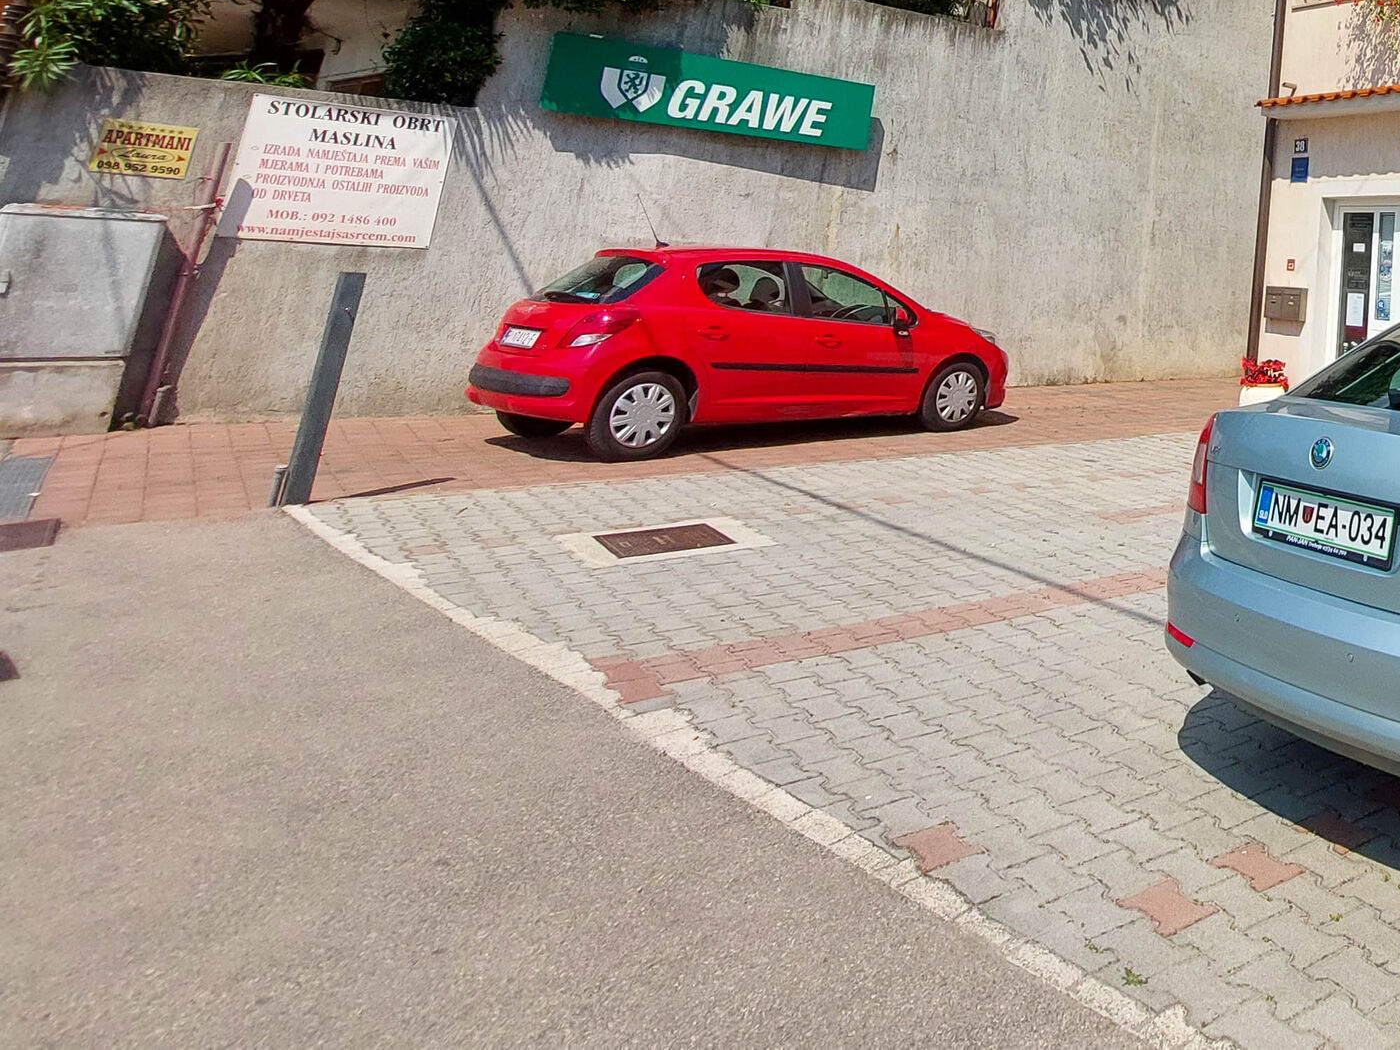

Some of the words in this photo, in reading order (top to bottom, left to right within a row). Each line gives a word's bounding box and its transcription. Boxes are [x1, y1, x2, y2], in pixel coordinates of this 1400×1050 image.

[268, 101, 382, 126] STOLARSKI
[393, 115, 445, 133] OBRT
[667, 79, 833, 138] GRAWE
[102, 129, 193, 151] APARTMANI
[308, 128, 396, 150] MASLINA
[1295, 140, 1305, 152] 38
[118, 149, 168, 161] Laura
[263, 144, 300, 157] IZRADA
[306, 148, 369, 164] NAMJEŠTAJA
[374, 154, 406, 168] PREMA
[413, 156, 440, 170] VAŠIM
[96, 160, 120, 170] 098
[124, 163, 148, 173] 952
[150, 165, 181, 175] 9590
[259, 158, 309, 173] MJERAMA
[314, 164, 320, 174] I
[324, 165, 384, 179] POTREBAMA
[251, 187, 267, 199] OD
[272, 189, 312, 203] DRVETA
[255, 173, 326, 189] PROIZVODNJA
[331, 180, 372, 193] OSTALIH
[376, 183, 429, 198] PROIZVODA
[266, 209, 308, 222] MOB.:
[311, 212, 335, 223] 092
[339, 213, 371, 225] 1486
[373, 216, 397, 227] 400
[237, 224, 416, 243] www.namjestajsasrcem.com
[1270, 492, 1302, 527] NM
[1313, 502, 1388, 549] EA-034
